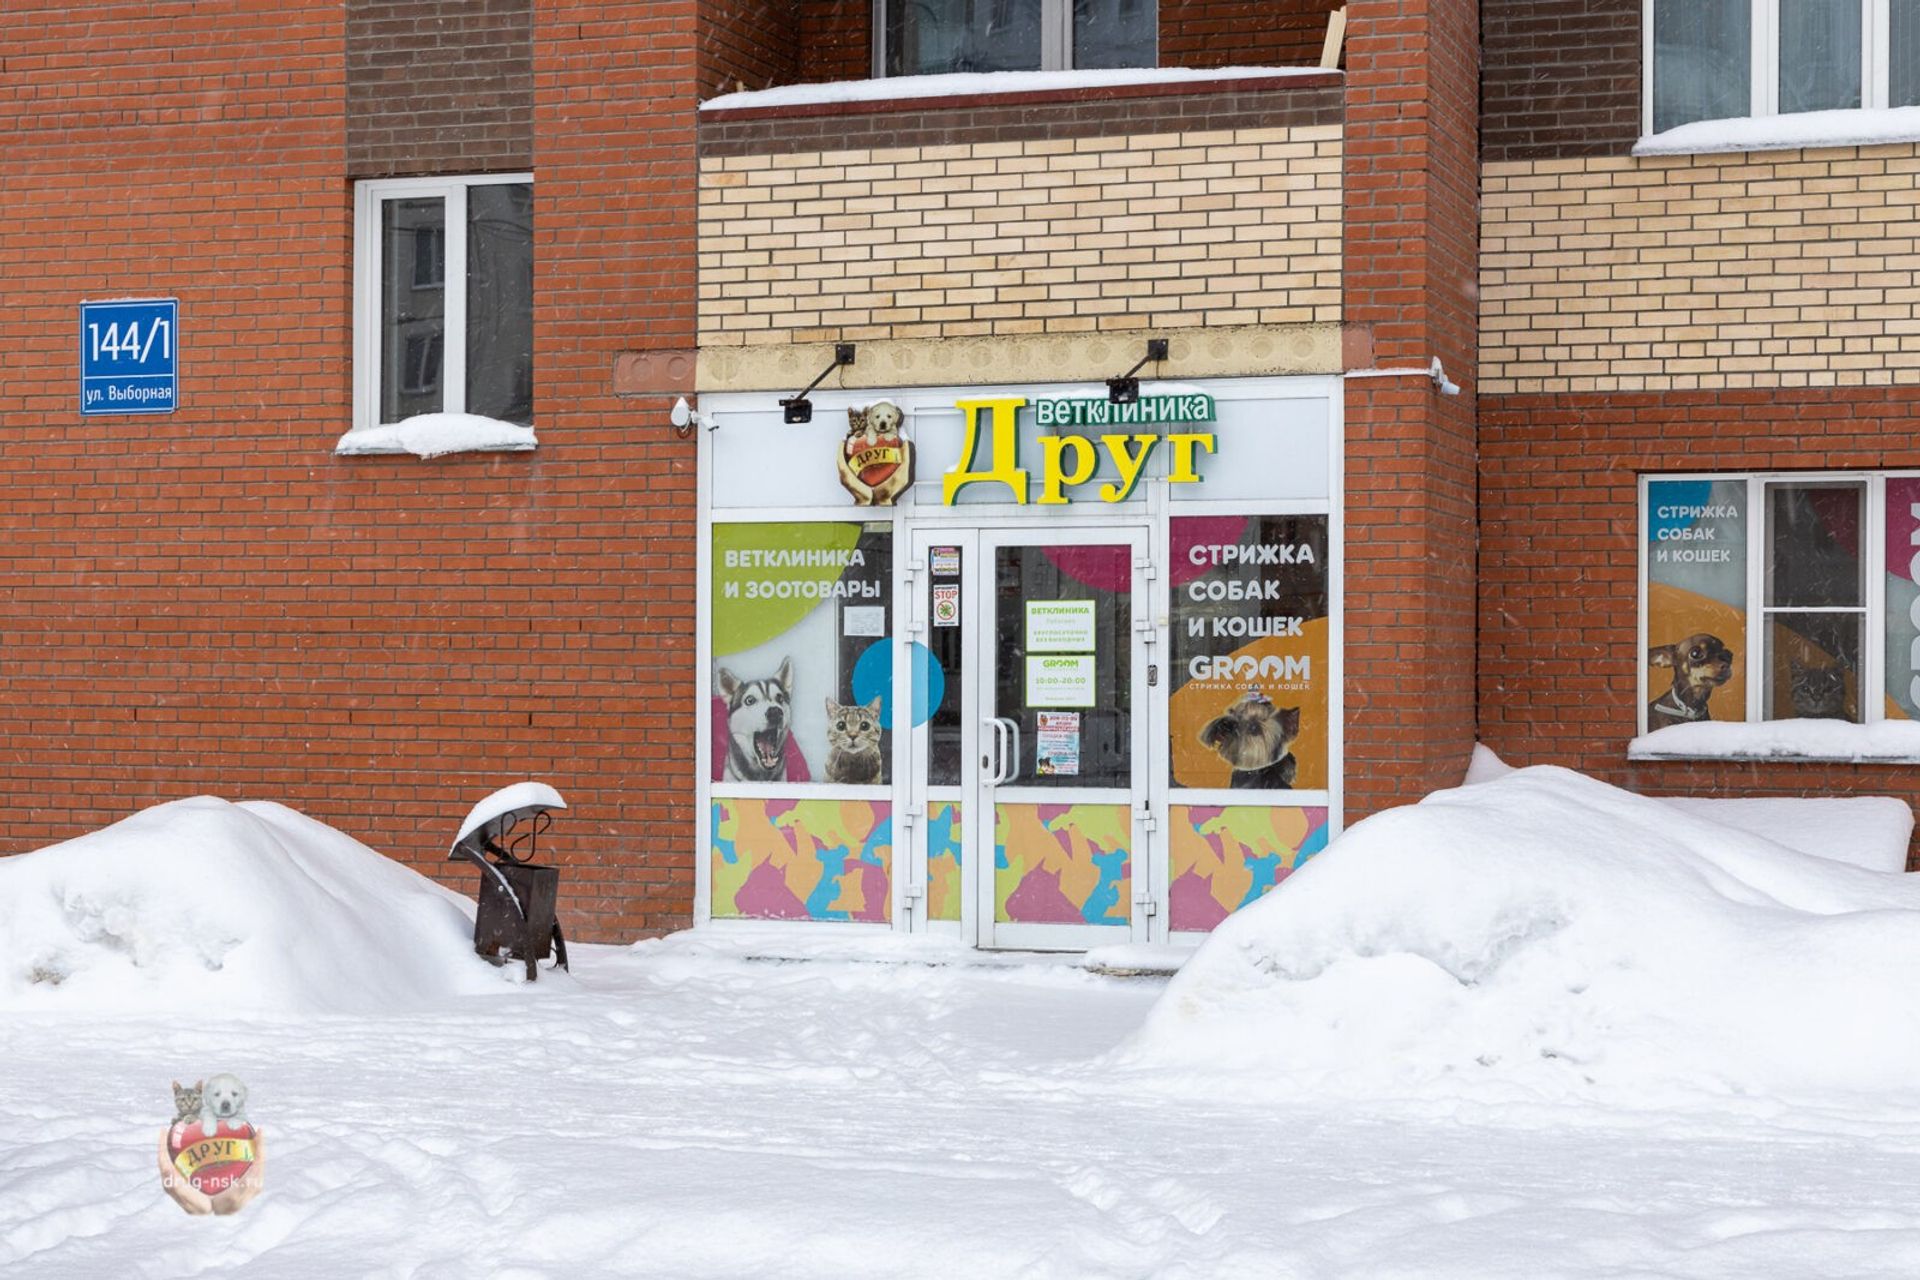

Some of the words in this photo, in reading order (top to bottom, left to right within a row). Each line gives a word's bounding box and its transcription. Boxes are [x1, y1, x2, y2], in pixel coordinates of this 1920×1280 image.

[88, 317, 170, 363] 144/1
[86, 389, 104, 405] ул.
[108, 384, 172, 403] Выборная
[1037, 395, 1211, 425] ветклиника
[856, 448, 890, 467] ДРУГ
[943, 397, 1215, 506] Друг
[1657, 504, 1738, 519] СТРИЖКА
[1657, 527, 1715, 541] СОБАК
[725, 549, 866, 568] ВЕТКЛИНИКА
[1188, 544, 1315, 565] СТРИЖКА
[1657, 550, 1668, 563] И
[1672, 550, 1731, 563] КОШЕК
[724, 580, 739, 599] И
[745, 580, 881, 599] ЗООТОВАРЫ
[935, 591, 957, 600] STOP
[1188, 580, 1281, 601] СОБАК
[1031, 607, 1089, 615] ВЕТКЛИНИКА
[1188, 616, 1205, 637] И
[1213, 616, 1304, 637] КОШЕК
[1043, 660, 1079, 668] GROOM
[1189, 655, 1311, 681] GROOM
